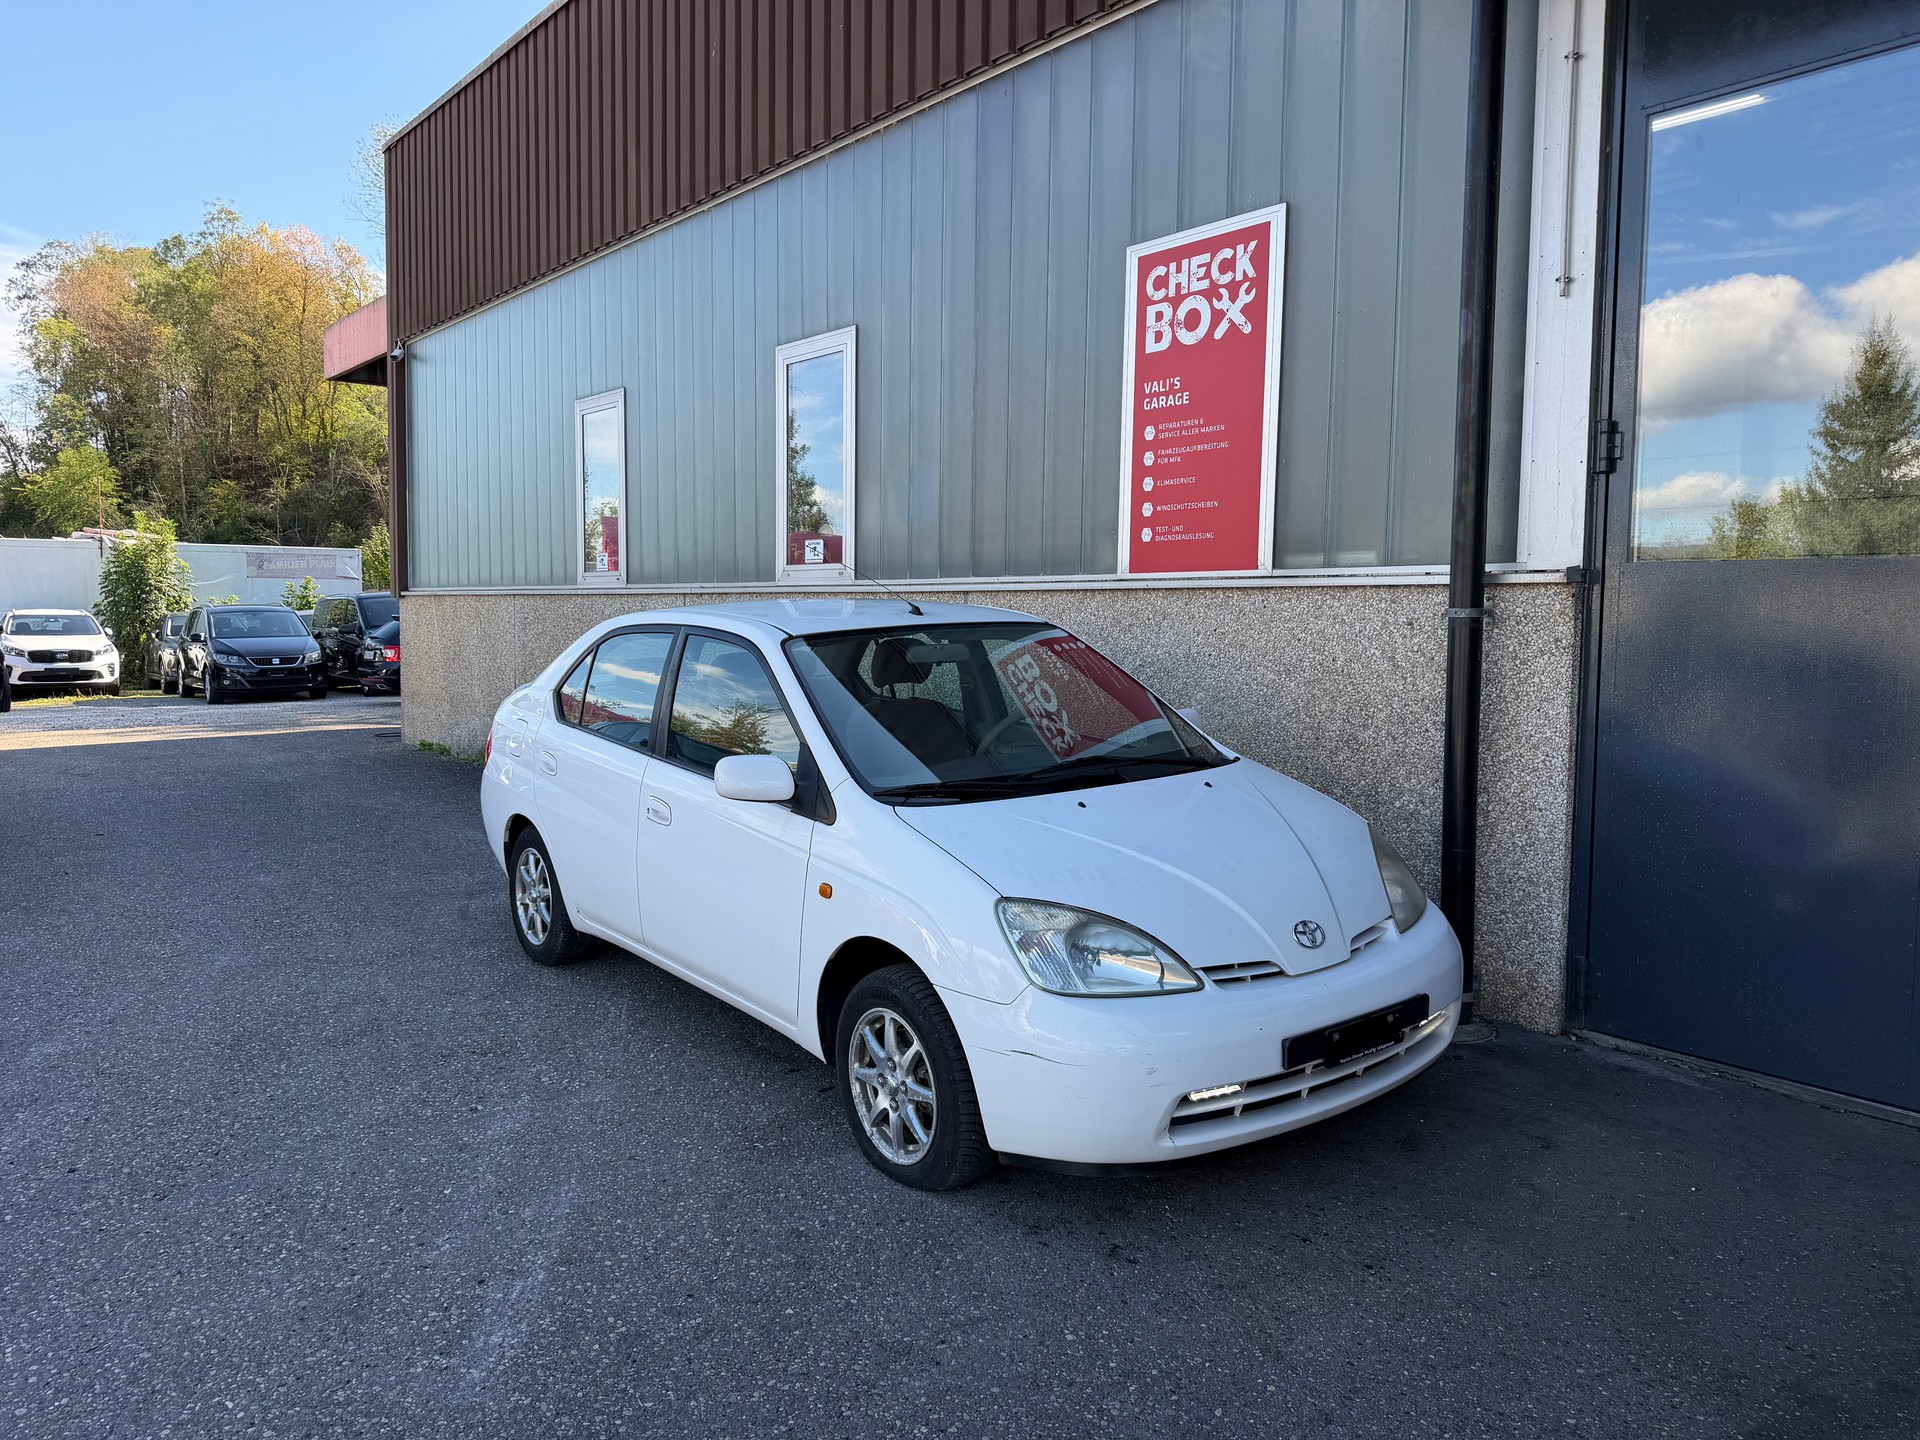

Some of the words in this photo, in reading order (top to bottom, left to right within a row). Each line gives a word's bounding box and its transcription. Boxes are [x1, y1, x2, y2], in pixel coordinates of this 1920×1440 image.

[1146, 240, 1258, 301] CHECK
[1145, 282, 1256, 354] BOX
[1144, 377, 1181, 394] VALI'S
[1143, 392, 1190, 411] GARAGE
[1158, 419, 1199, 431] REPARATUREN
[1158, 430, 1181, 440] SERVICE
[1181, 427, 1199, 436] ALLER
[1200, 424, 1225, 434] MARKEN
[1157, 441, 1229, 456] FAHRZEUGAUFBEREITUNG
[1157, 456, 1169, 465] FÜR
[1157, 476, 1196, 487] KLIMASERVICE
[1156, 501, 1219, 512] WINDSCHUTZSCHEIBEN
[1155, 532, 1215, 542] DIAGNOSEAUSLESUNG
